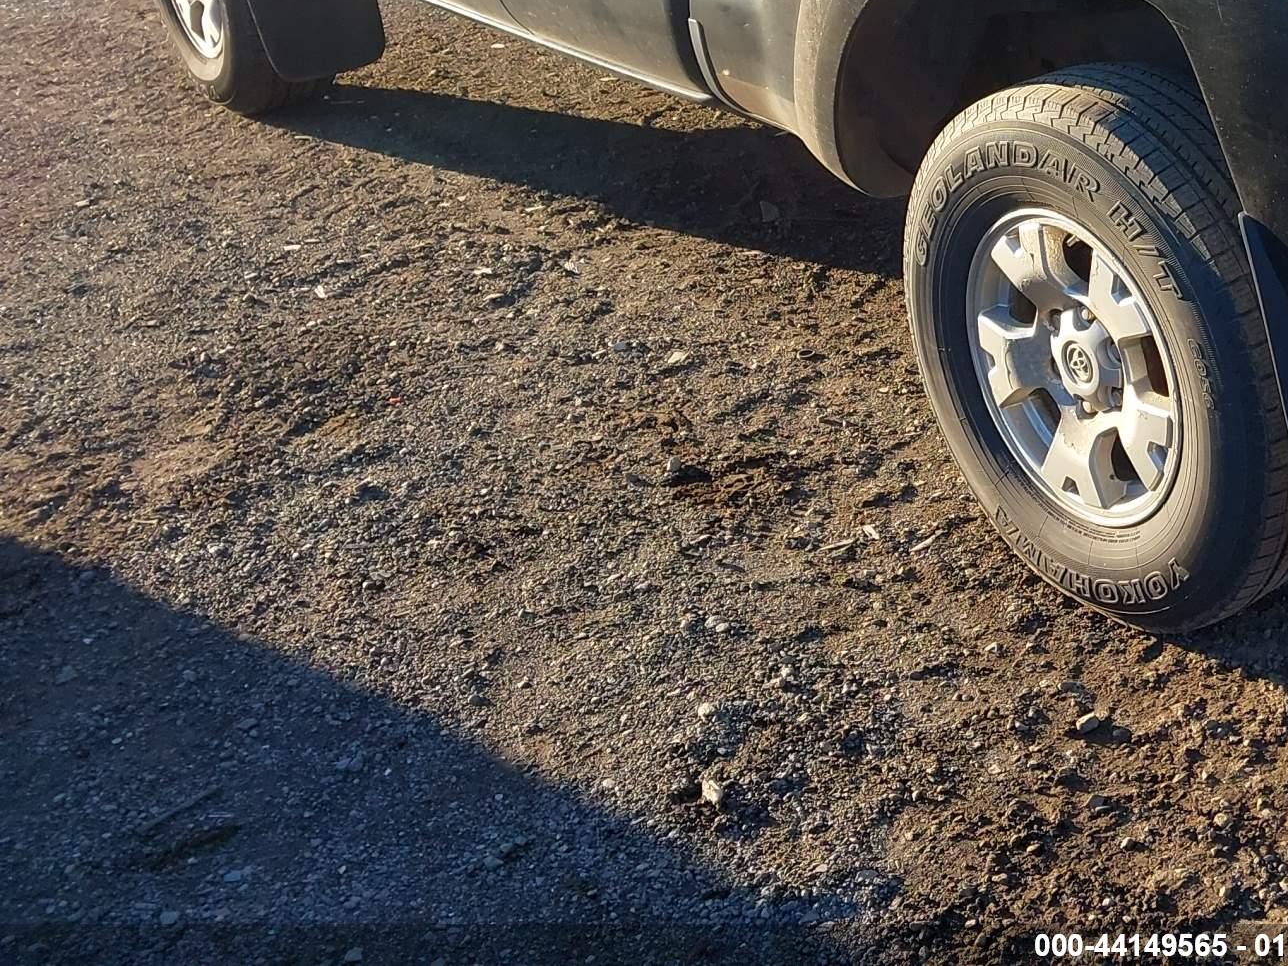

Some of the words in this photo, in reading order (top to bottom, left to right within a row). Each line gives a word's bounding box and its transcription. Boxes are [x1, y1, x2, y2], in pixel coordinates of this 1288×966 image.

[915, 140, 1101, 266] GEOLANDAR
[1107, 199, 1185, 301] H/T
[995, 504, 1191, 605] YOKOHAMA
